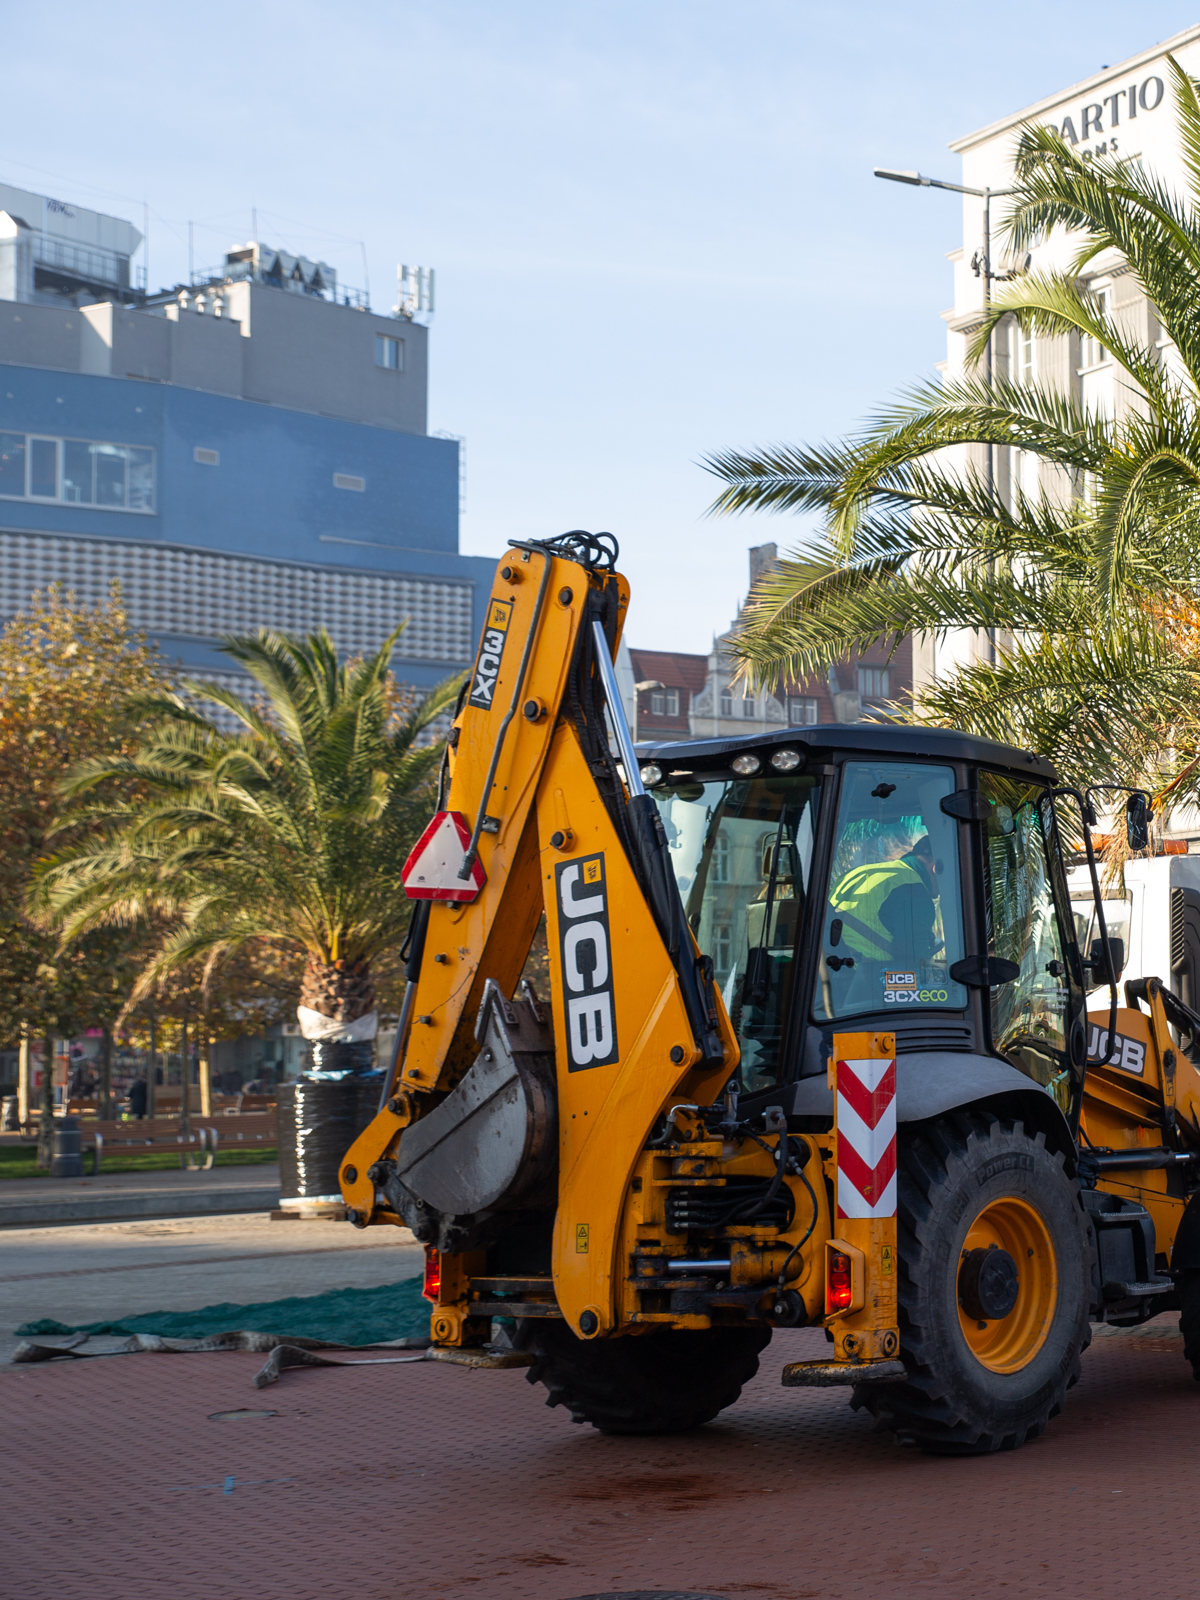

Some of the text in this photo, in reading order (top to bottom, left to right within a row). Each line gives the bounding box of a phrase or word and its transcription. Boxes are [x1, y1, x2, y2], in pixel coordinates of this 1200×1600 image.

[471, 630, 504, 700] 3CX
[560, 864, 613, 1065] JCB
[887, 974, 914, 984] JCB
[1088, 1026, 1144, 1073] JCB
[976, 1157, 1017, 1184] Power
